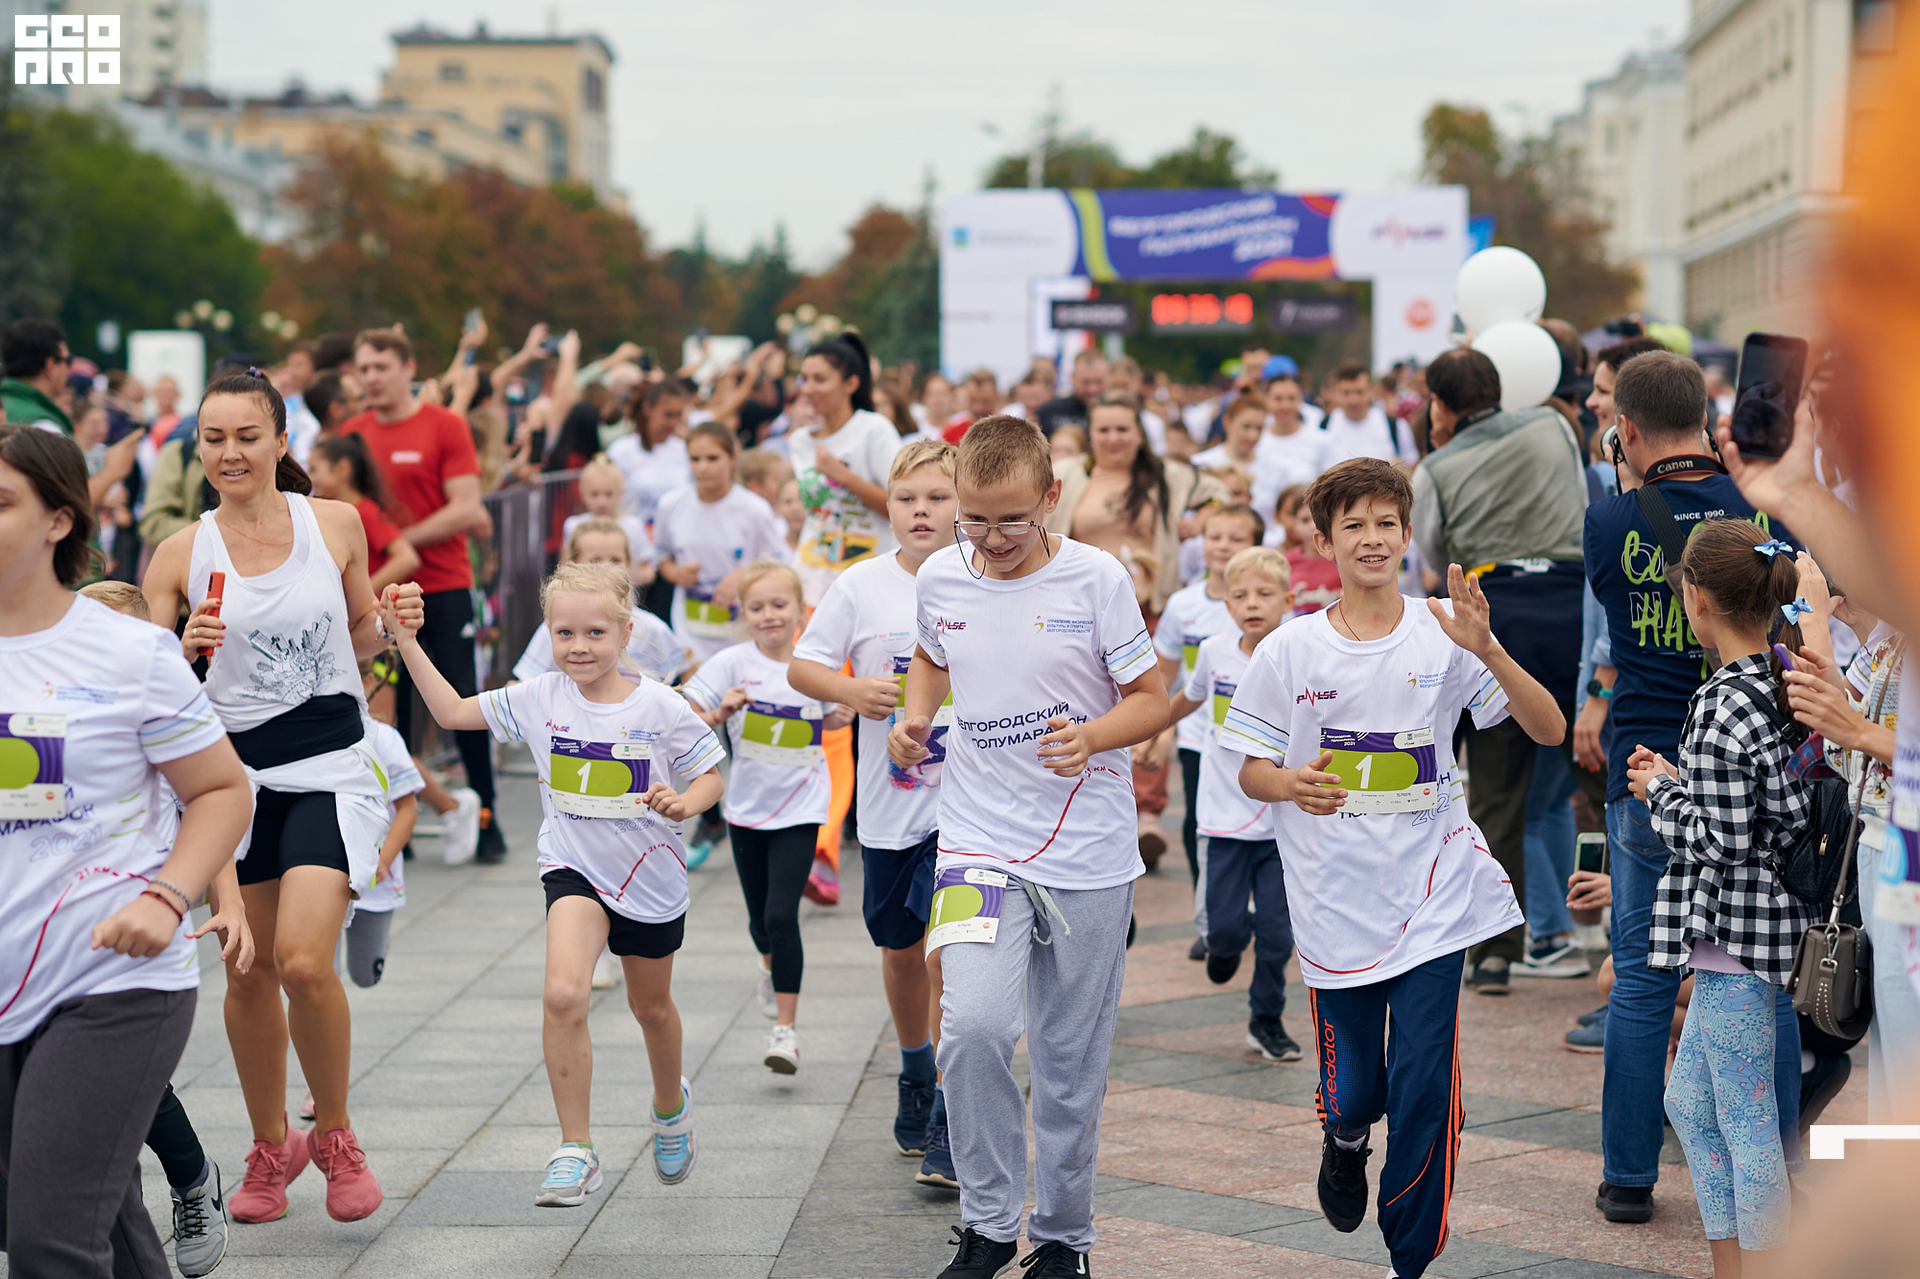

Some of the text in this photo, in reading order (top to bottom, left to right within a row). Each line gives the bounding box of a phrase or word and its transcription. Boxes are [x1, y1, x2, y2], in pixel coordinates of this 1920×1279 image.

[1657, 460, 1694, 474] Canon
[1673, 509, 1725, 522] SINCE 1990
[769, 720, 786, 746] 1
[972, 715, 1088, 749] ОЛУМАРАОН
[577, 762, 592, 793] 1
[1355, 755, 1373, 789] 1
[934, 890, 946, 926] 1
[1324, 1018, 1342, 1117] predator
